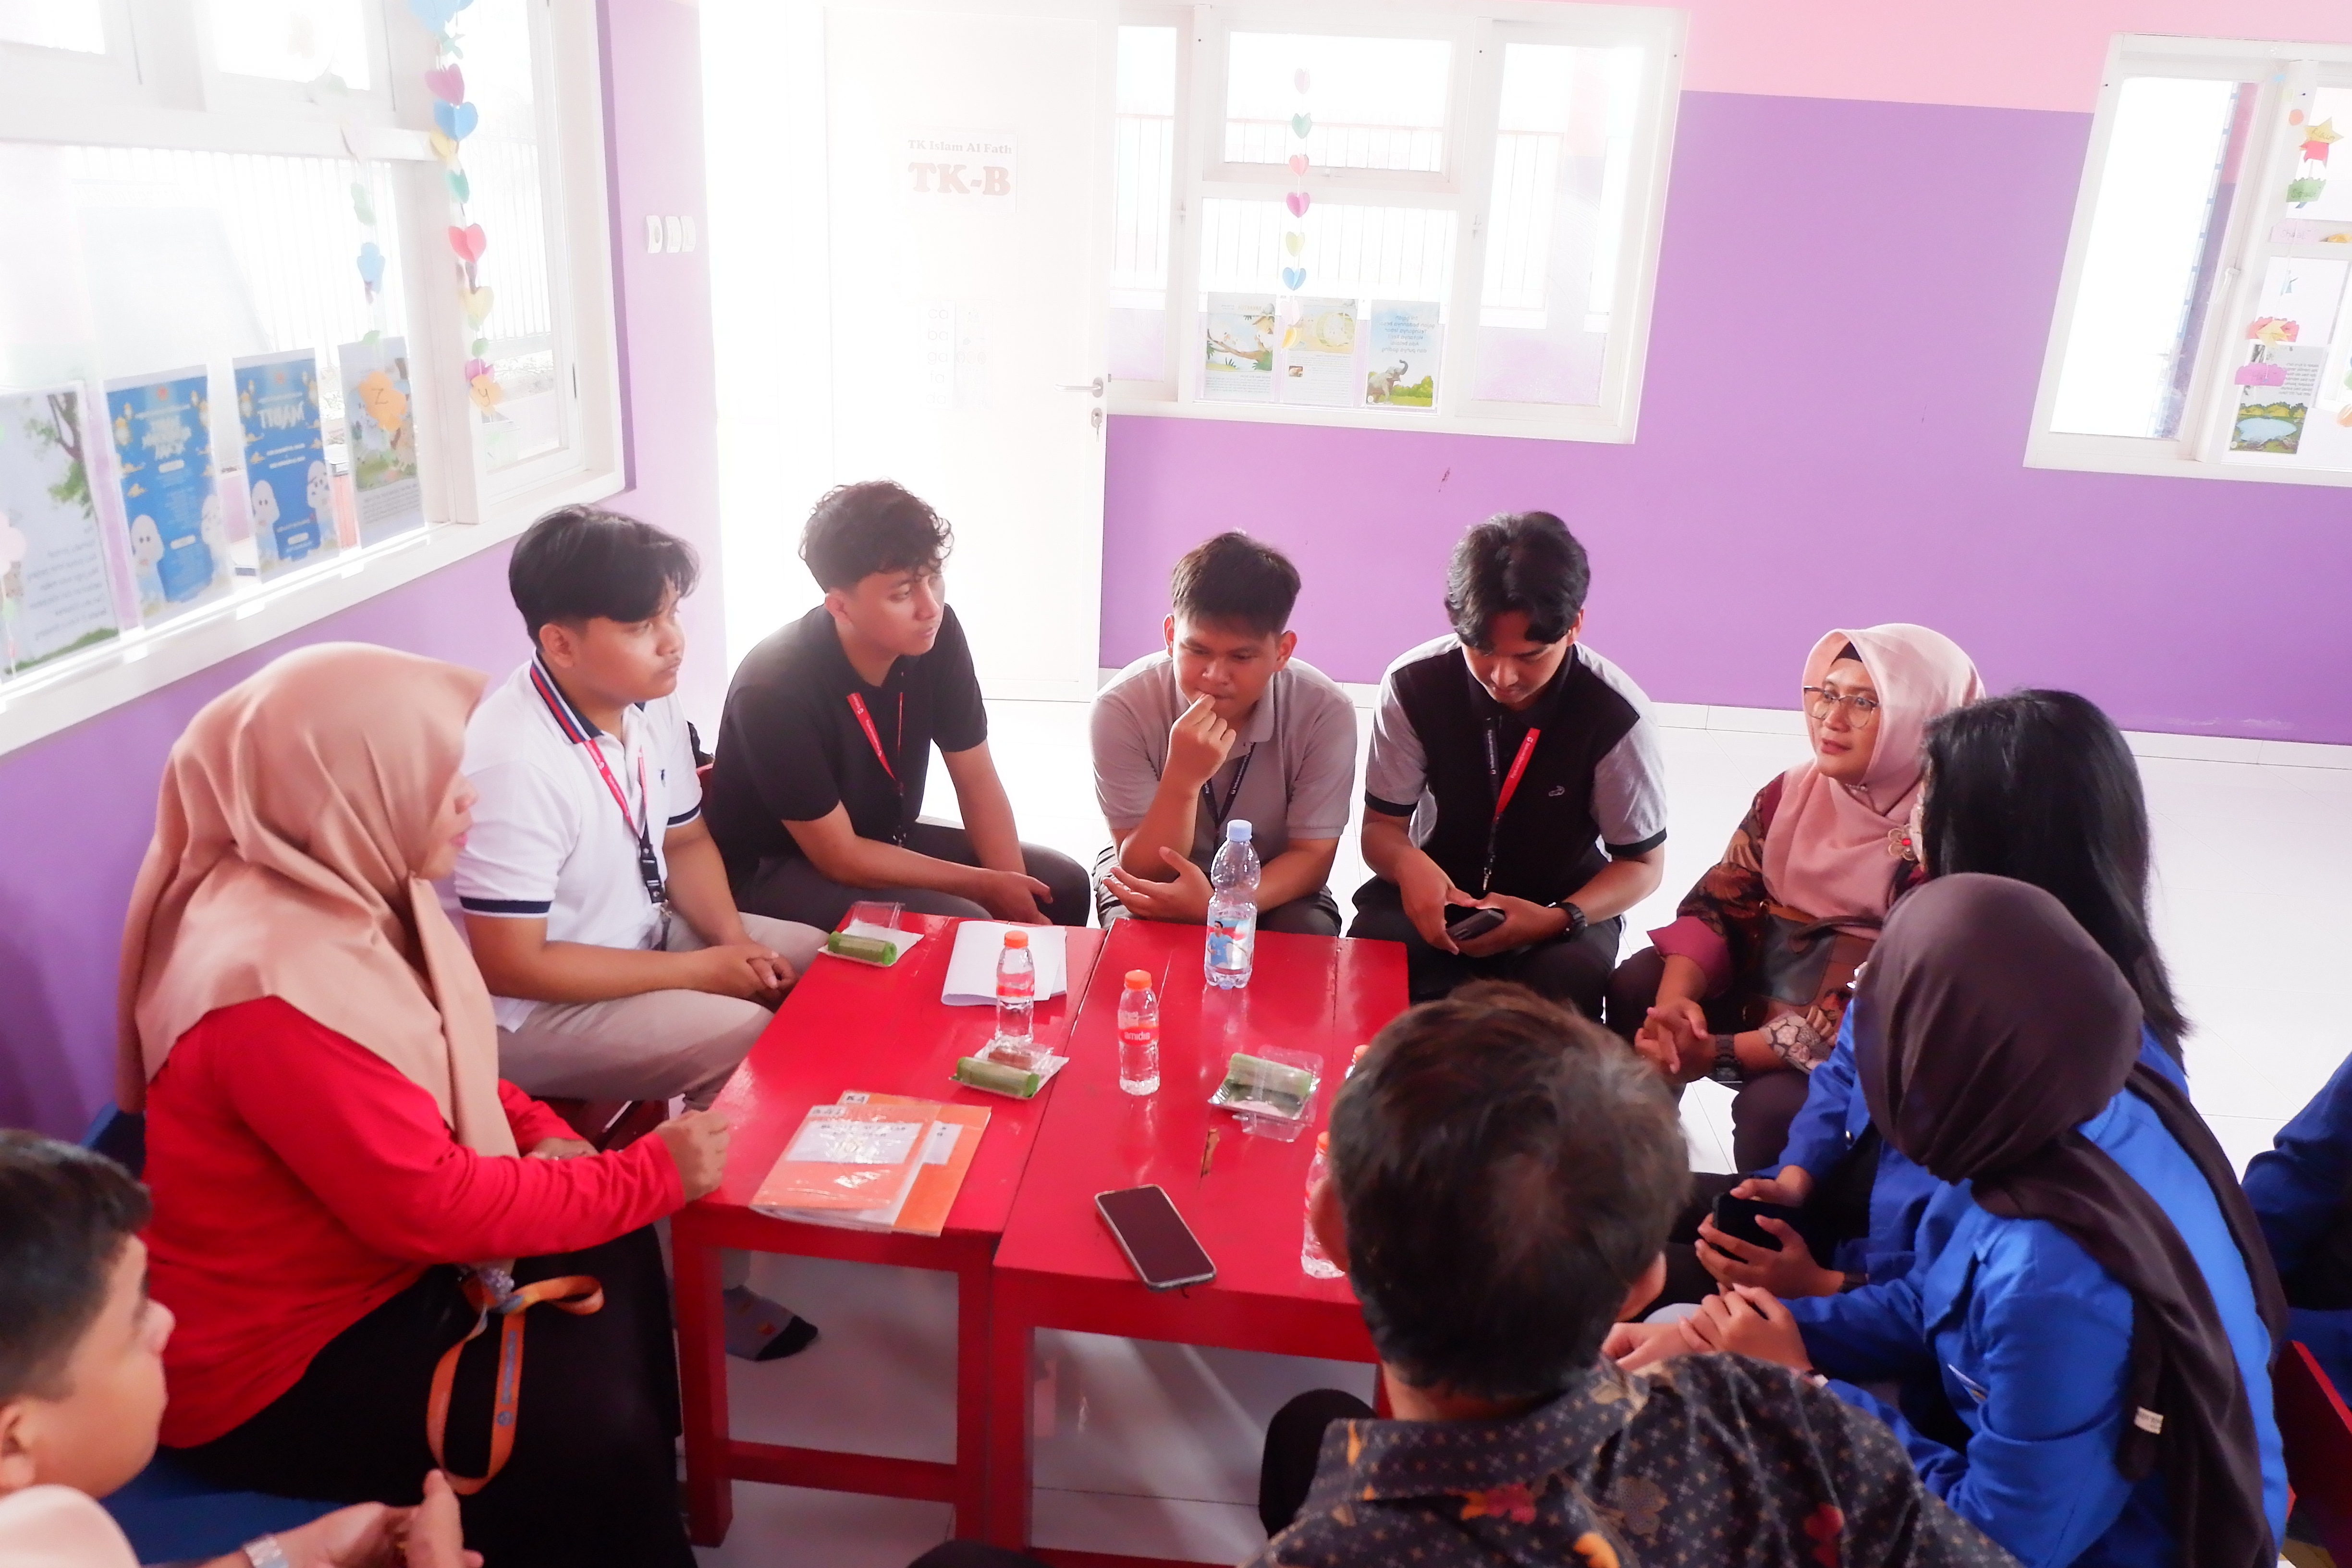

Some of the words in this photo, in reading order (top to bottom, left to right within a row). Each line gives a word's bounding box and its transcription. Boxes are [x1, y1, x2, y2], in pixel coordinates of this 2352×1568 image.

[907, 139, 926, 150] TK
[930, 141, 963, 152] Islam
[966, 143, 981, 153] Al
[984, 144, 1012, 154] Fath
[907, 162, 1011, 196] TK-B
[928, 308, 948, 319] ca
[928, 327, 948, 341] ba
[927, 352, 948, 365] ga
[930, 370, 944, 383] fa
[926, 392, 946, 404] da
